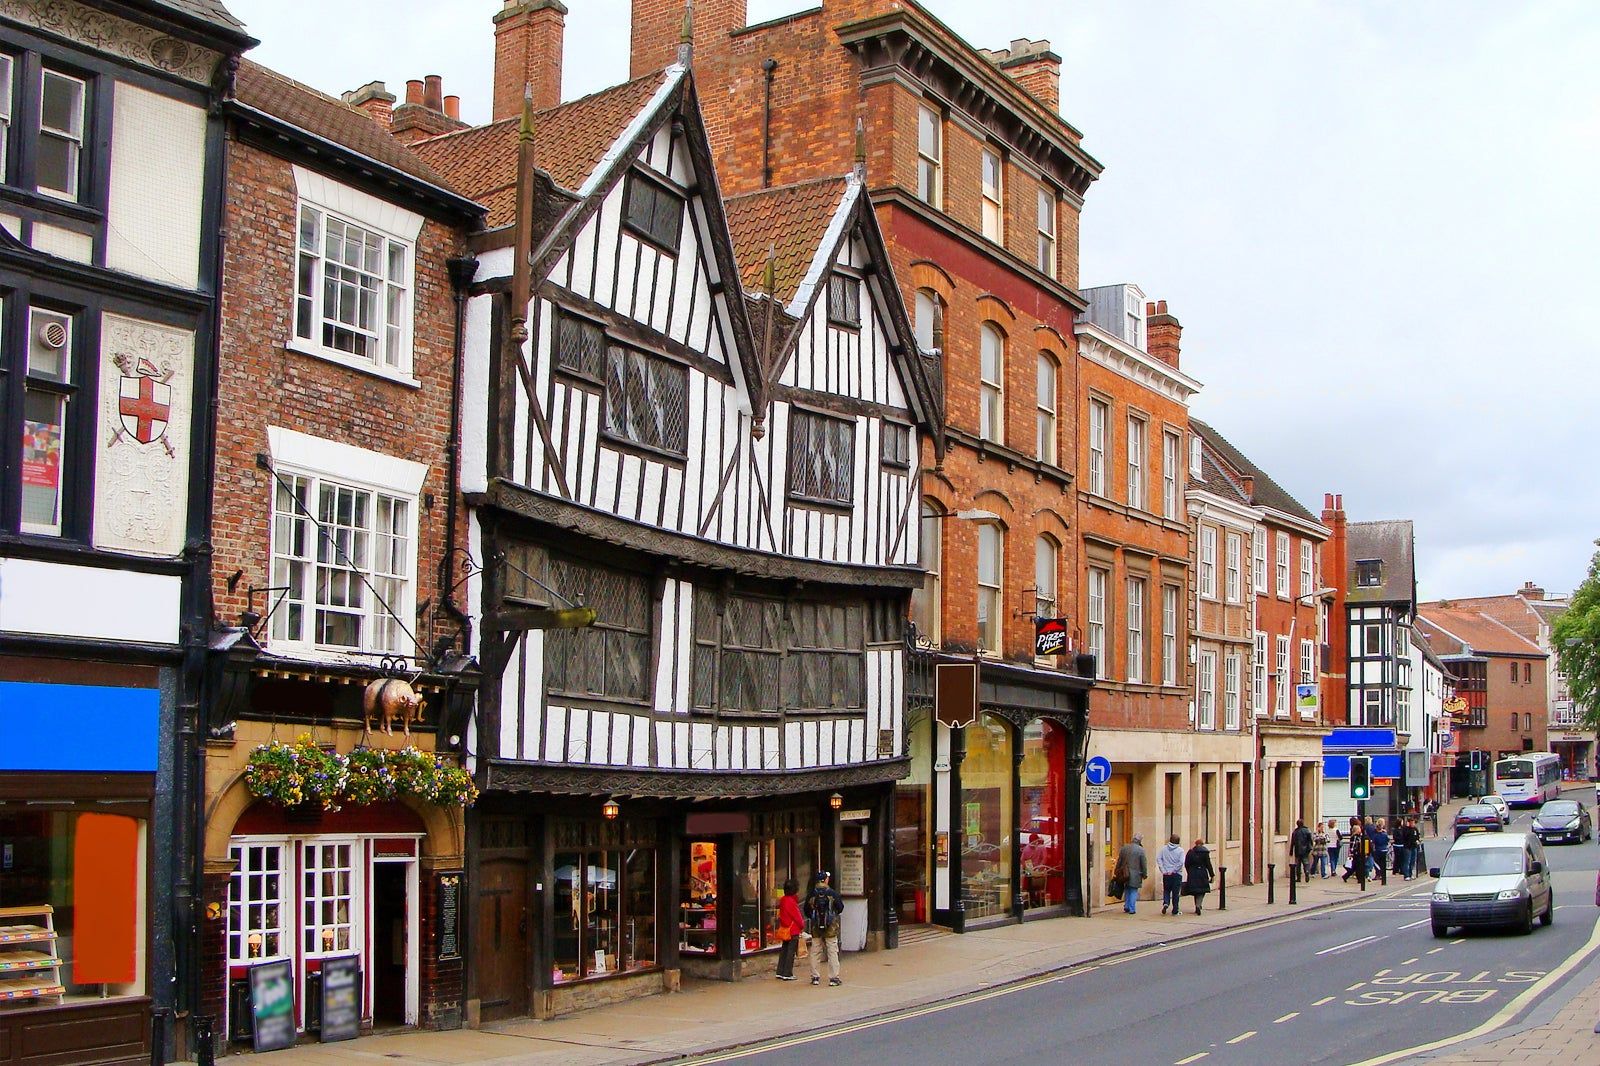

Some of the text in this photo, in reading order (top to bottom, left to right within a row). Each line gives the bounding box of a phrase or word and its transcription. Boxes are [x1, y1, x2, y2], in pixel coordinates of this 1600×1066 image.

[1037, 631, 1065, 647] Pizza
[1042, 639, 1062, 651] Hut
[1371, 971, 1547, 984] STOP
[1344, 989, 1498, 1005] BUS
